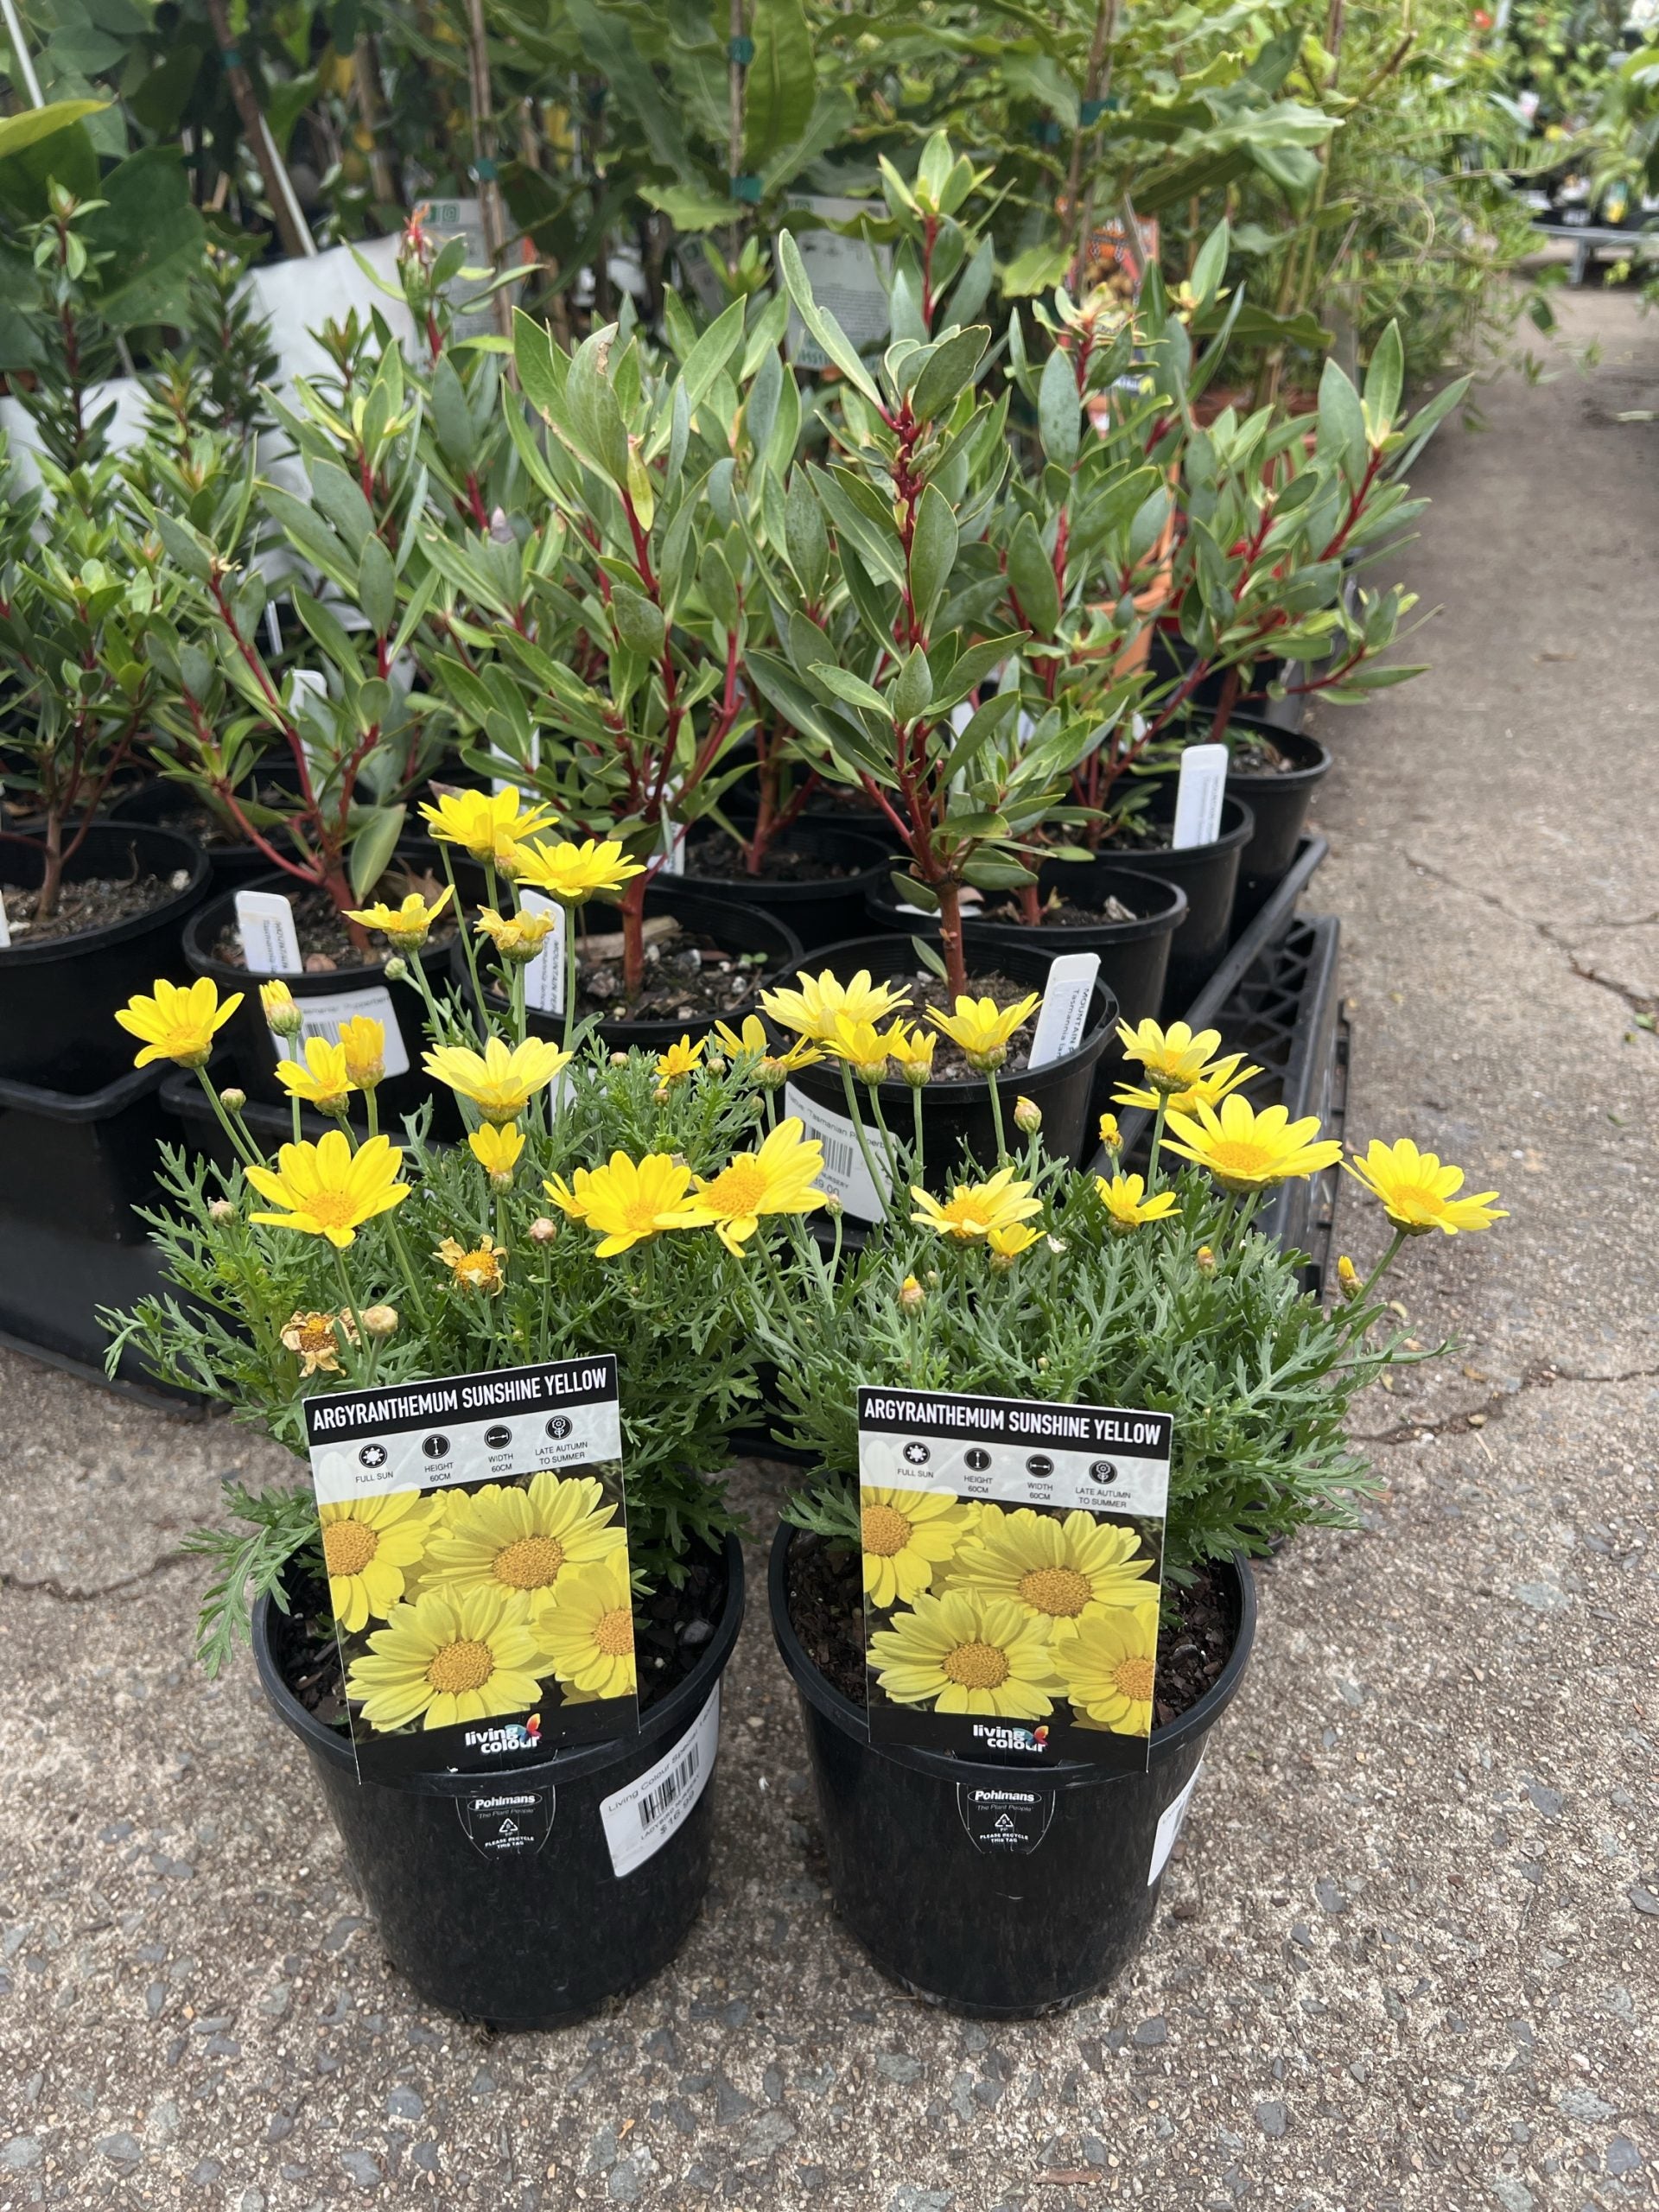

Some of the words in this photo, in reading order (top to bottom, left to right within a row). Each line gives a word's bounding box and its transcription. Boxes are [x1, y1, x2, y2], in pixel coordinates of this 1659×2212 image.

[1060, 988, 1080, 1040] Tasmannia
[1070, 988, 1090, 1044] MOUNTAIN
[314, 1389, 458, 1431] ARGYRANTHEMUM
[462, 1376, 542, 1408] SUNSHINE
[545, 1367, 607, 1395] YELLOW
[864, 1397, 1005, 1431] ARGYRANTHEMUM
[1008, 1410, 1090, 1440] SUNSHINE
[1094, 1419, 1161, 1446] YELLOW
[535, 1446, 554, 1457] LATE
[556, 1441, 588, 1453] AUTUMN
[488, 1452, 514, 1463] WIDTH
[539, 1456, 550, 1465] TO
[550, 1452, 586, 1464] SUMMER
[424, 1461, 454, 1473] HEIGHT
[492, 1463, 512, 1472] 60CM
[897, 1468, 915, 1478] FULL
[916, 1470, 934, 1478] SUN
[355, 1472, 376, 1483] FULL
[377, 1471, 394, 1481] SUN
[429, 1472, 451, 1483] 60CM
[963, 1475, 993, 1485] HEIGHT
[968, 1484, 989, 1494] 60CM
[1027, 1482, 1053, 1491] WIDTH
[1075, 1487, 1095, 1497] LATE
[1096, 1489, 1131, 1499] AUTUMN
[1029, 1491, 1051, 1501] 60CM
[1078, 1497, 1090, 1505] TO
[1091, 1498, 1127, 1508] SUMMER
[465, 1726, 518, 1746] living
[973, 1725, 1026, 1742] living
[480, 1735, 540, 1754] colour
[987, 1738, 1046, 1752] colour
[608, 1790, 639, 1813] Living
[641, 1764, 671, 1790] Colour
[974, 1789, 1035, 1802] Pohlmans
[474, 1796, 536, 1809] Pohlmans
[640, 1806, 675, 1840] LADYBIRD
[485, 1838, 507, 1847] PLEASE
